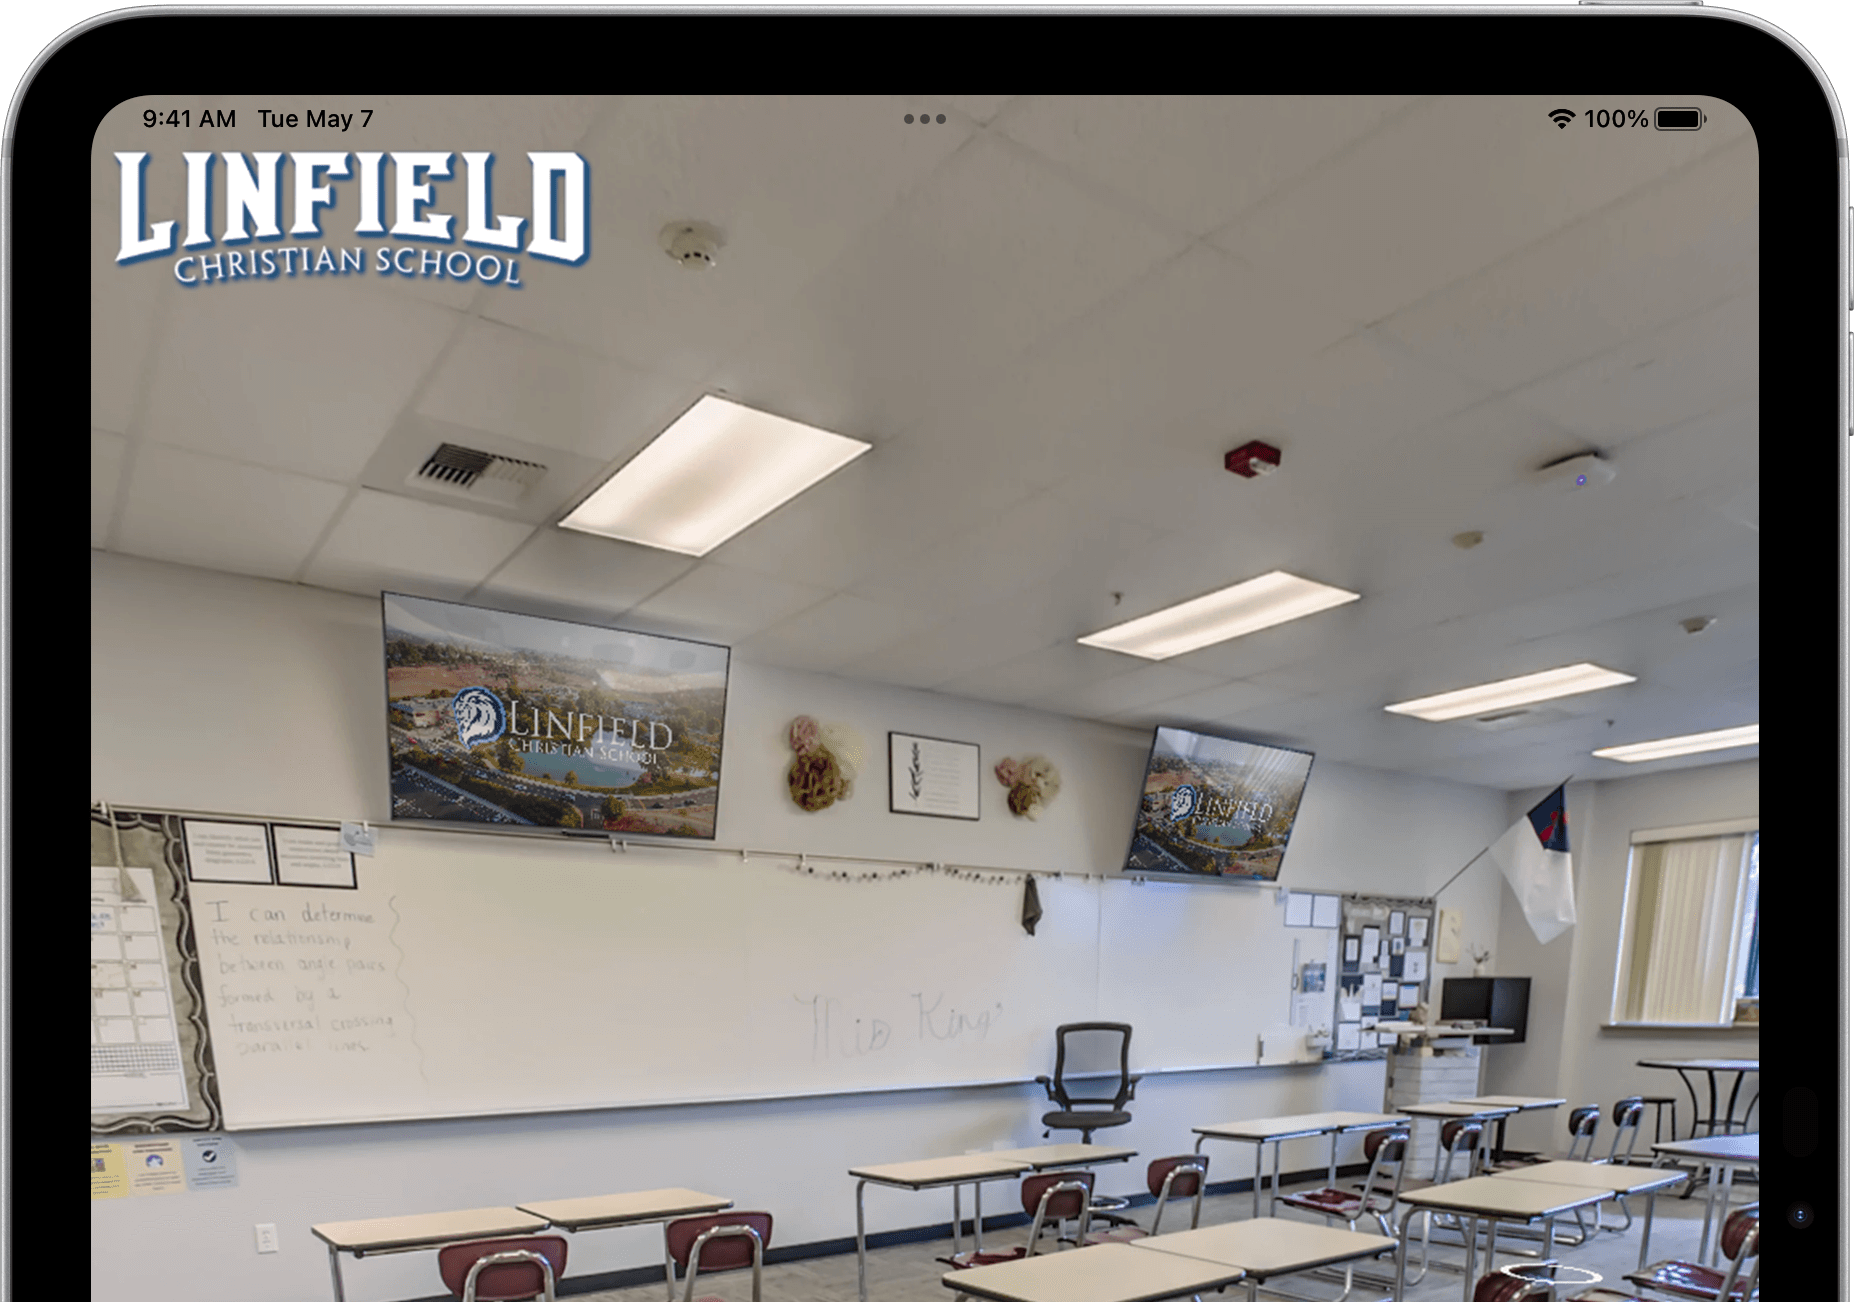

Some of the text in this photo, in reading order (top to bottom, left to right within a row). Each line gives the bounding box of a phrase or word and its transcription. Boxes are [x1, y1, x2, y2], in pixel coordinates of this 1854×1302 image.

[509, 699, 673, 750] LINFIELD
[205, 899, 376, 924] I can determine
[210, 927, 352, 951] the relationship
[217, 953, 285, 975] between
[297, 955, 336, 981] angle
[218, 983, 342, 1012] formed by a
